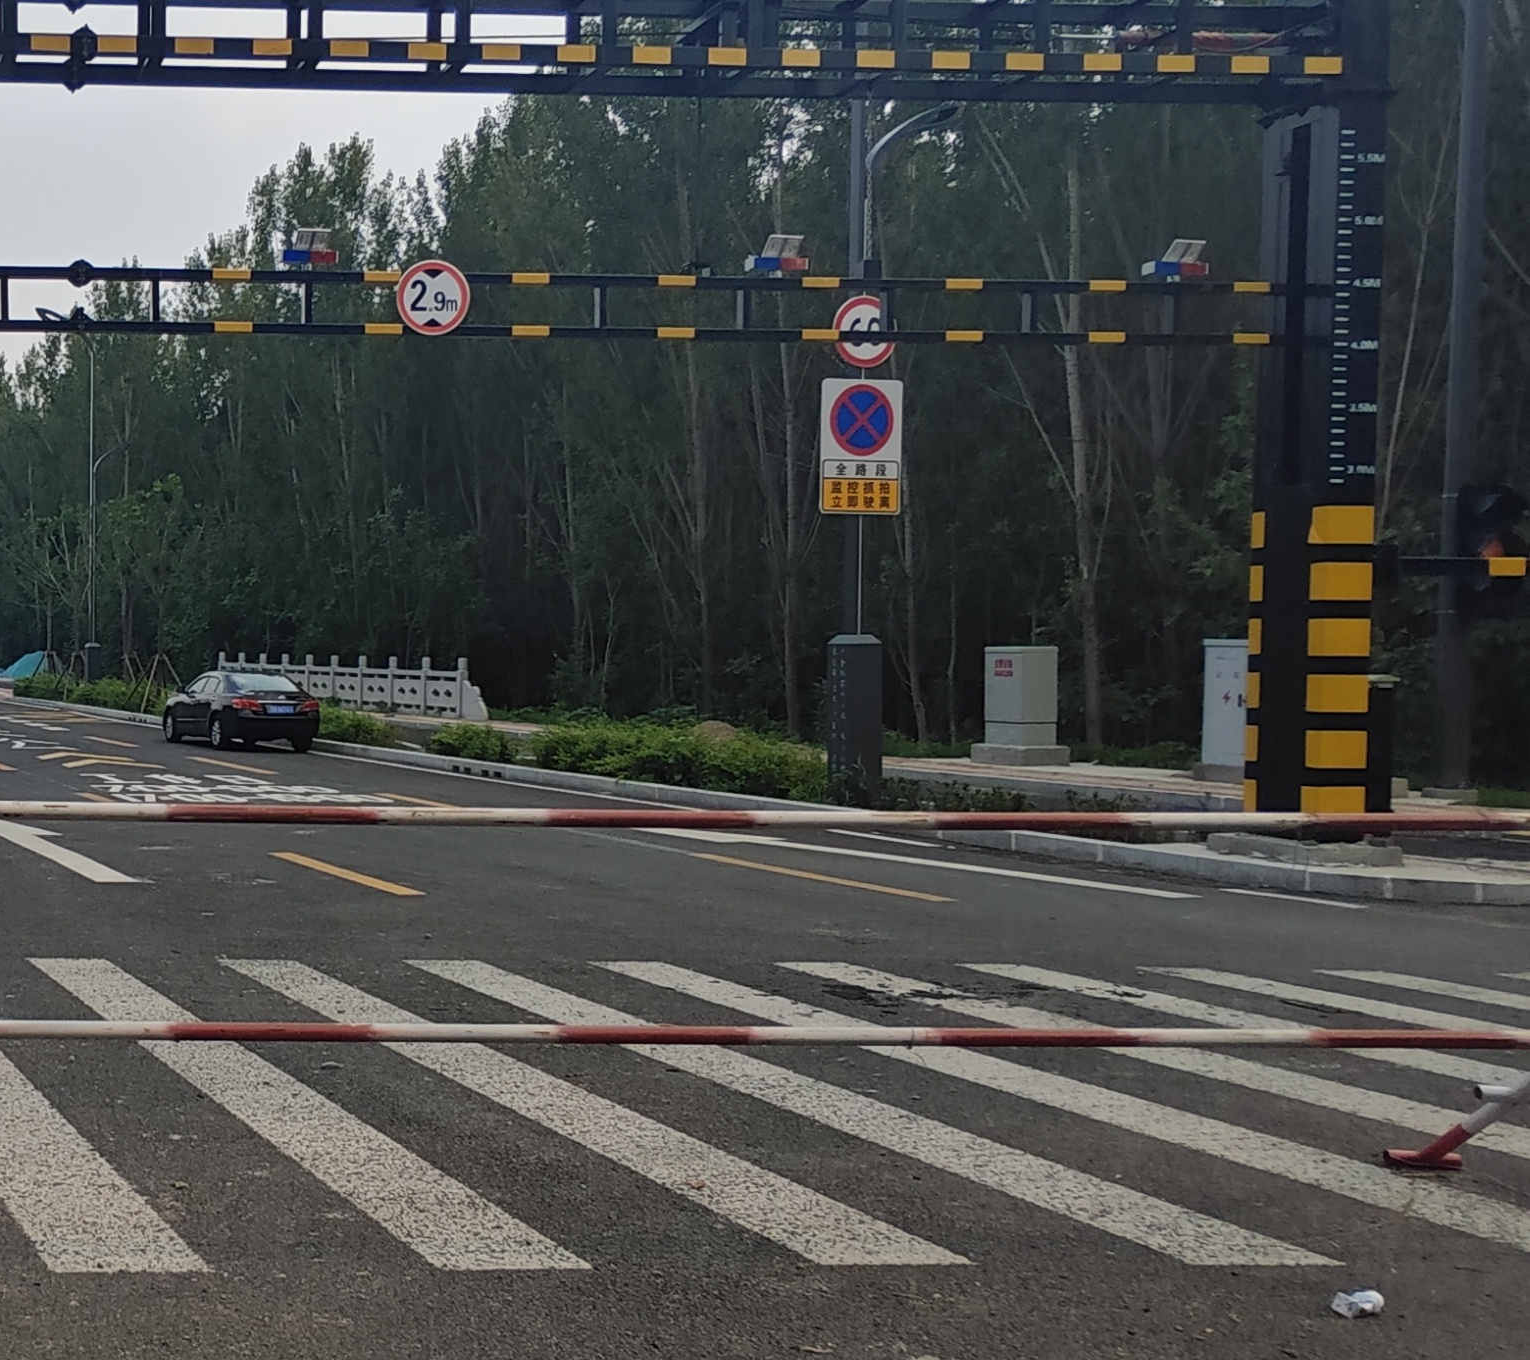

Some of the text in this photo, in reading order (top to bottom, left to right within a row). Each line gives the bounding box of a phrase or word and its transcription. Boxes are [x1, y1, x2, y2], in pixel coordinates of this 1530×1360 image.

[410, 279, 458, 312] 2.9m
[835, 462, 887, 477] 全路段
[831, 481, 890, 494] 监控抓拍
[831, 495, 890, 509] 立即驶离
